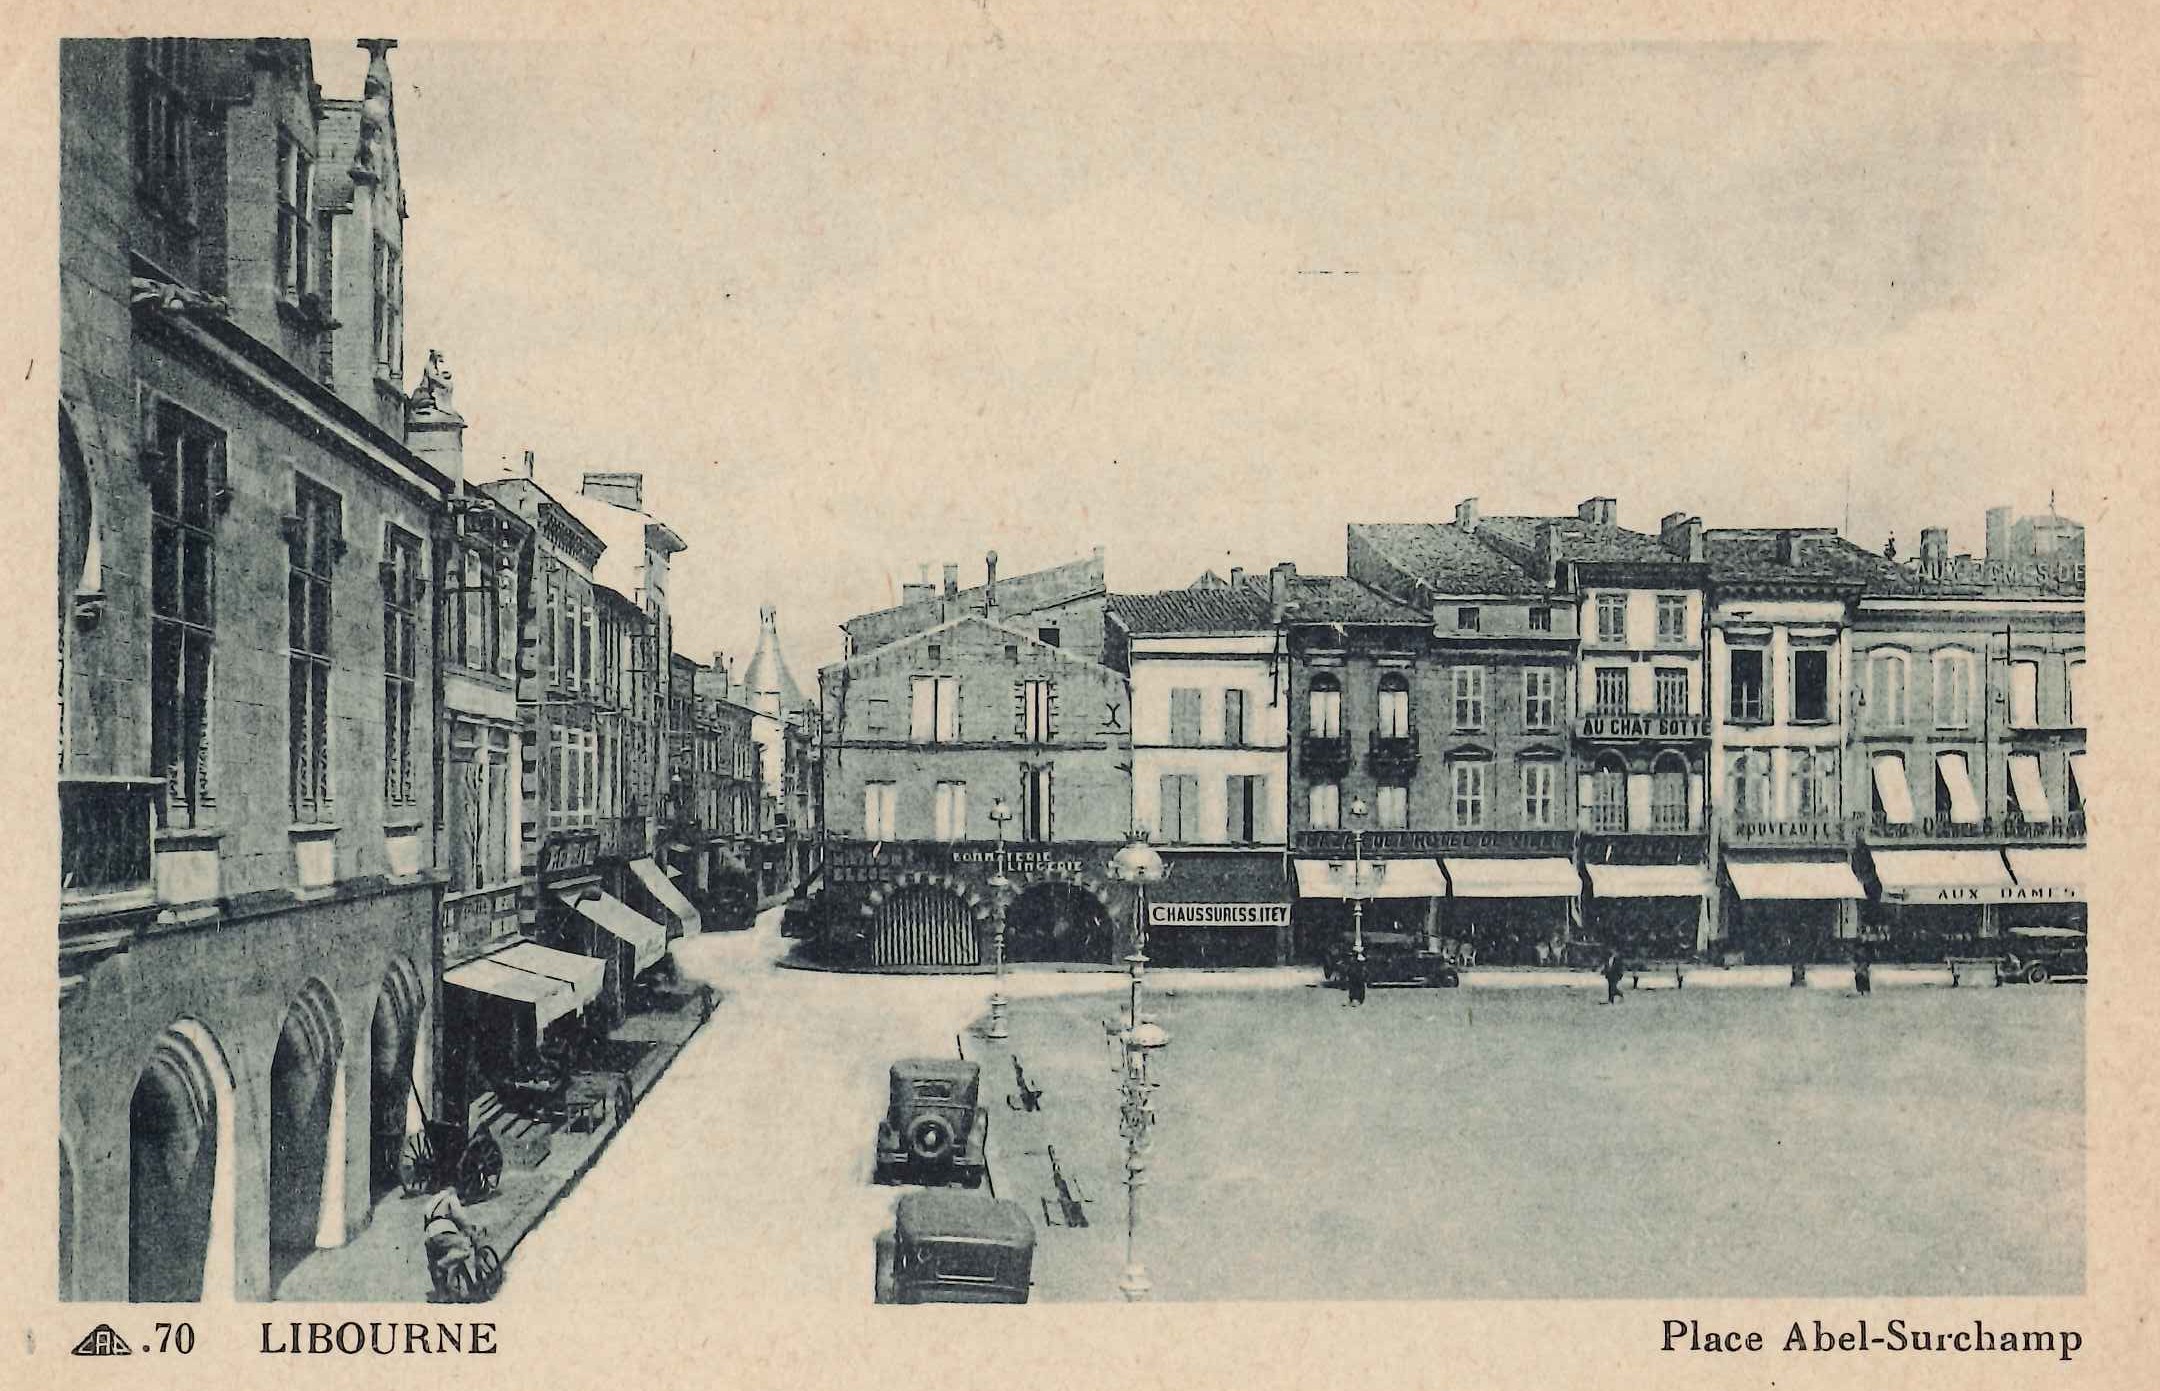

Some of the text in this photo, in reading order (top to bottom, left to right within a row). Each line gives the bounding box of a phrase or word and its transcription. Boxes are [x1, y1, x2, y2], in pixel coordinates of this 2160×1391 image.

[1583, 719, 1604, 736] AU
[1610, 719, 1652, 736] CHAT
[1938, 888, 1979, 900] AUX
[1152, 906, 1257, 923] CHAUSSURES
